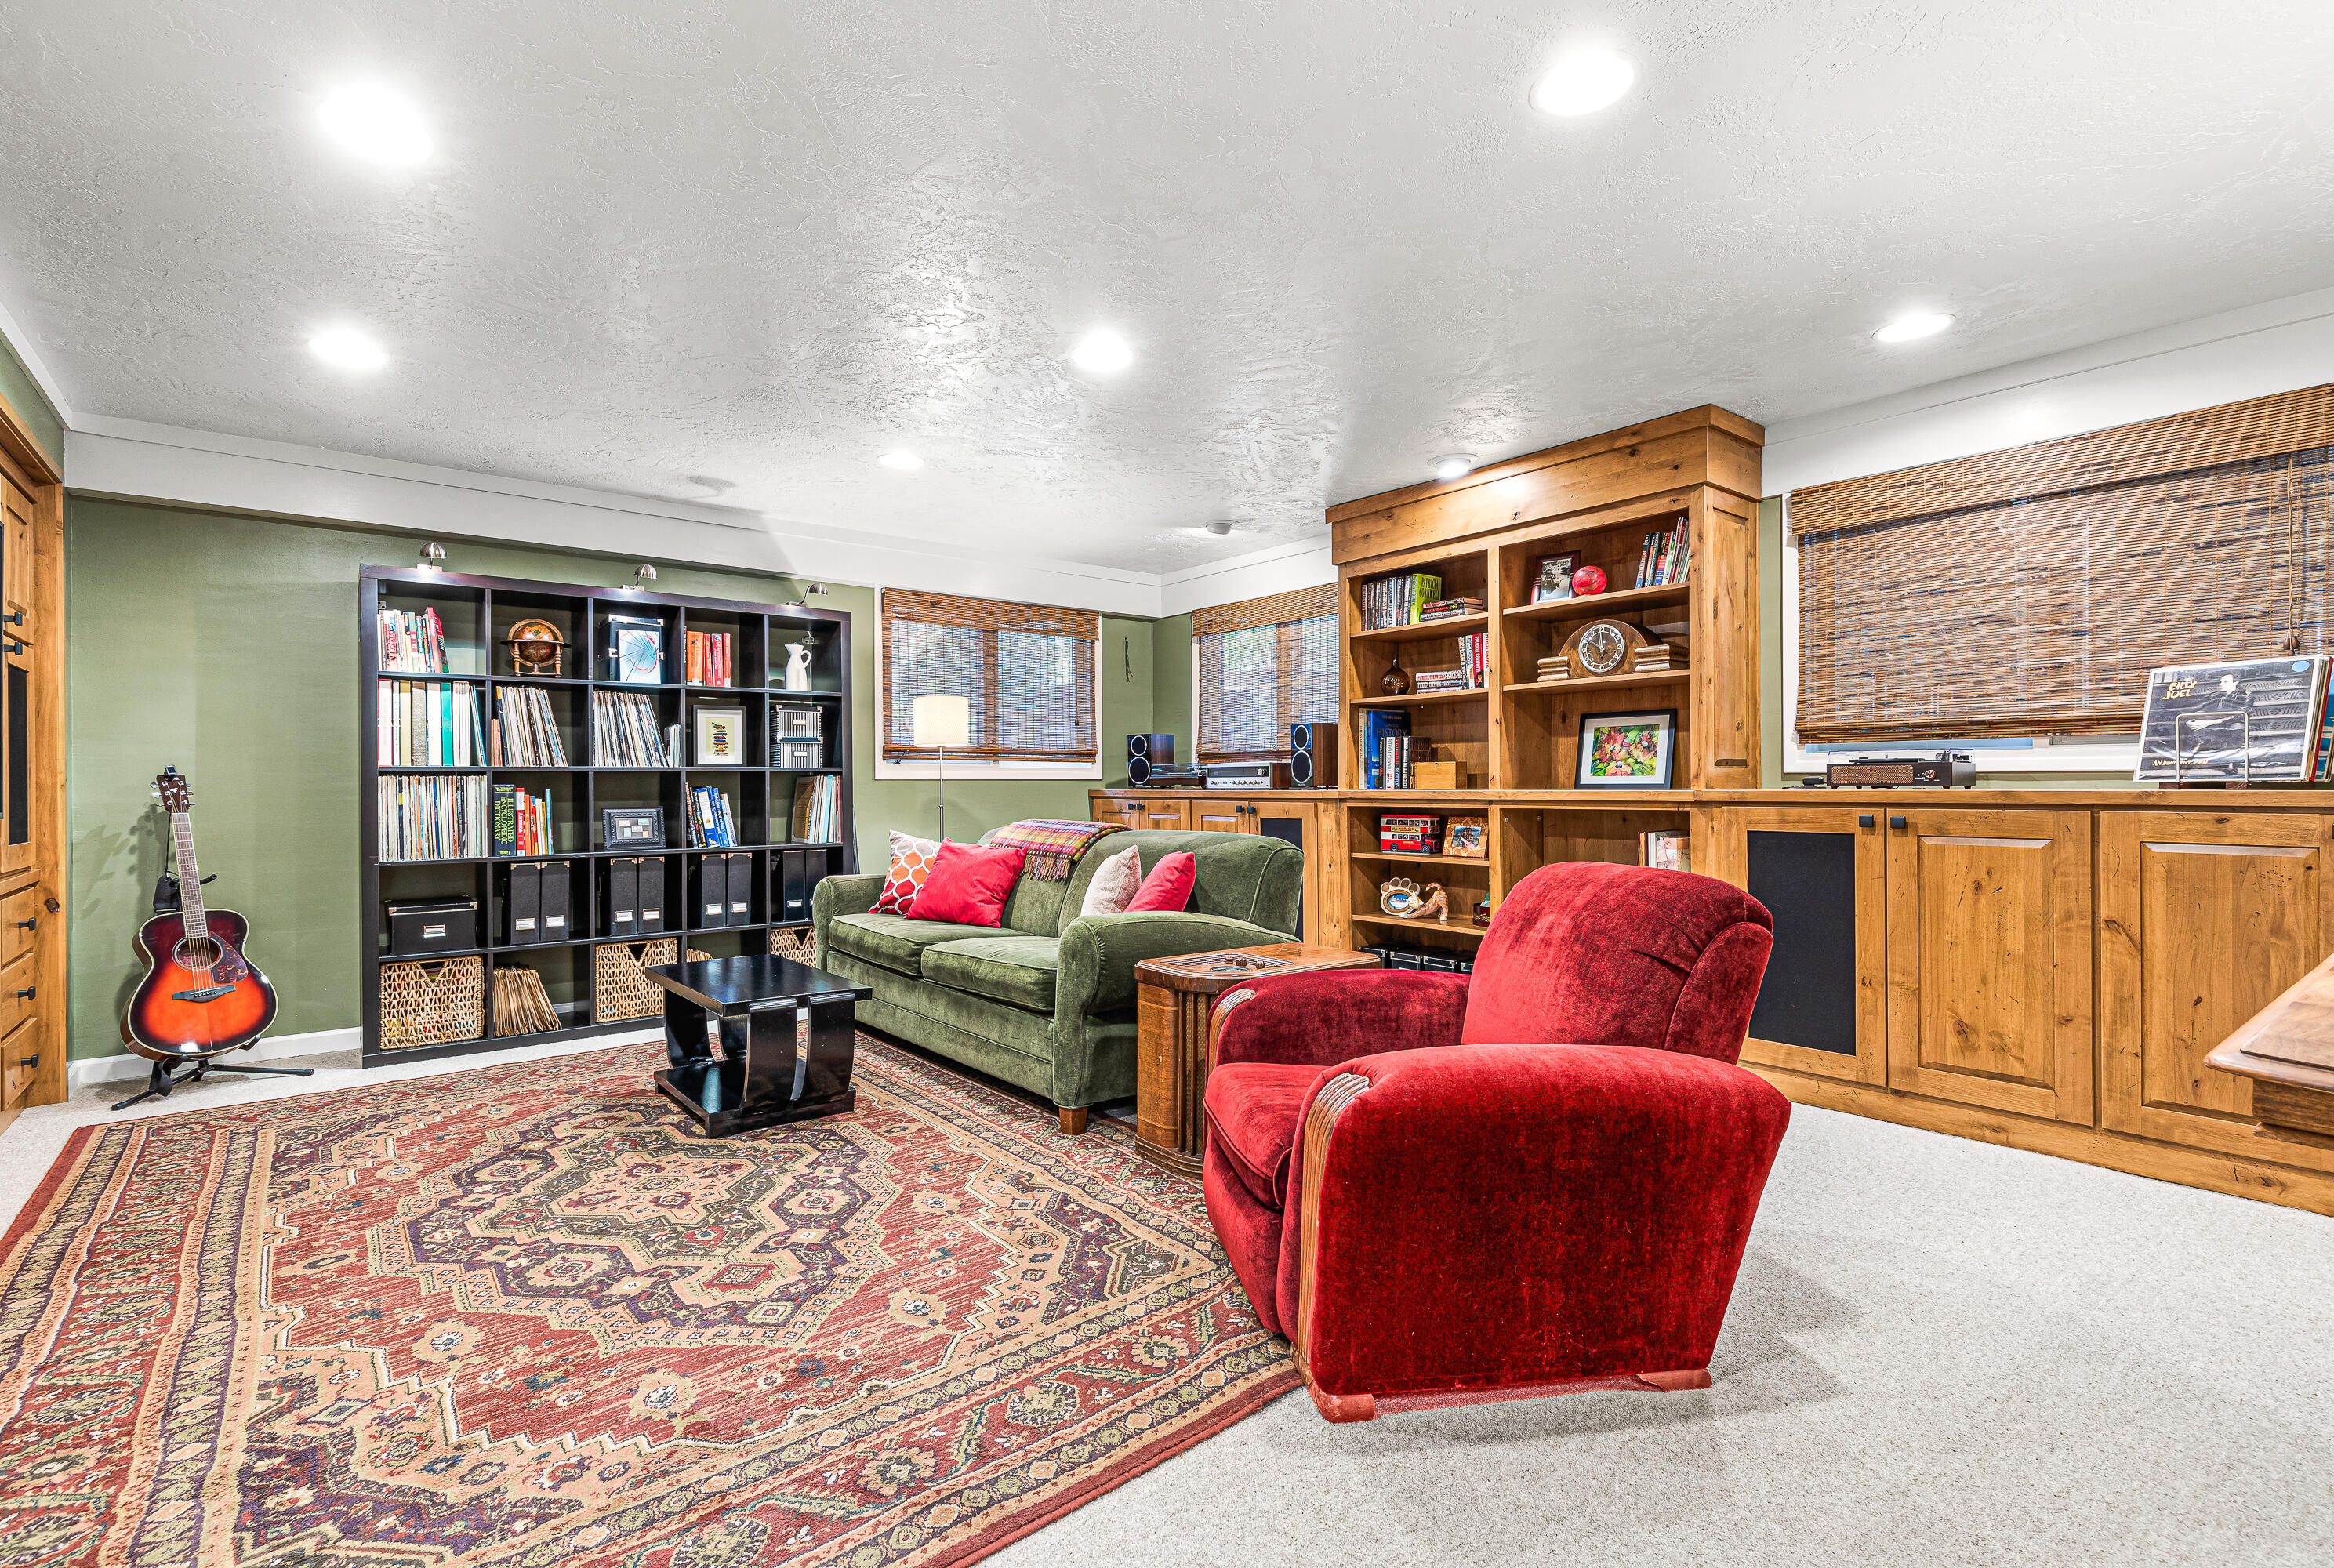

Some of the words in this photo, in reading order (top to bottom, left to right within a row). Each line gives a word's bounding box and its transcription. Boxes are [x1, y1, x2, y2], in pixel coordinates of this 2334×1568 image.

[1421, 576, 1440, 590] PATRICIA
[1419, 587, 1440, 600] CORNWELL
[2169, 681, 2198, 691] BILLY
[2162, 689, 2194, 700] JOEL
[1377, 728, 1407, 737] HISTORY
